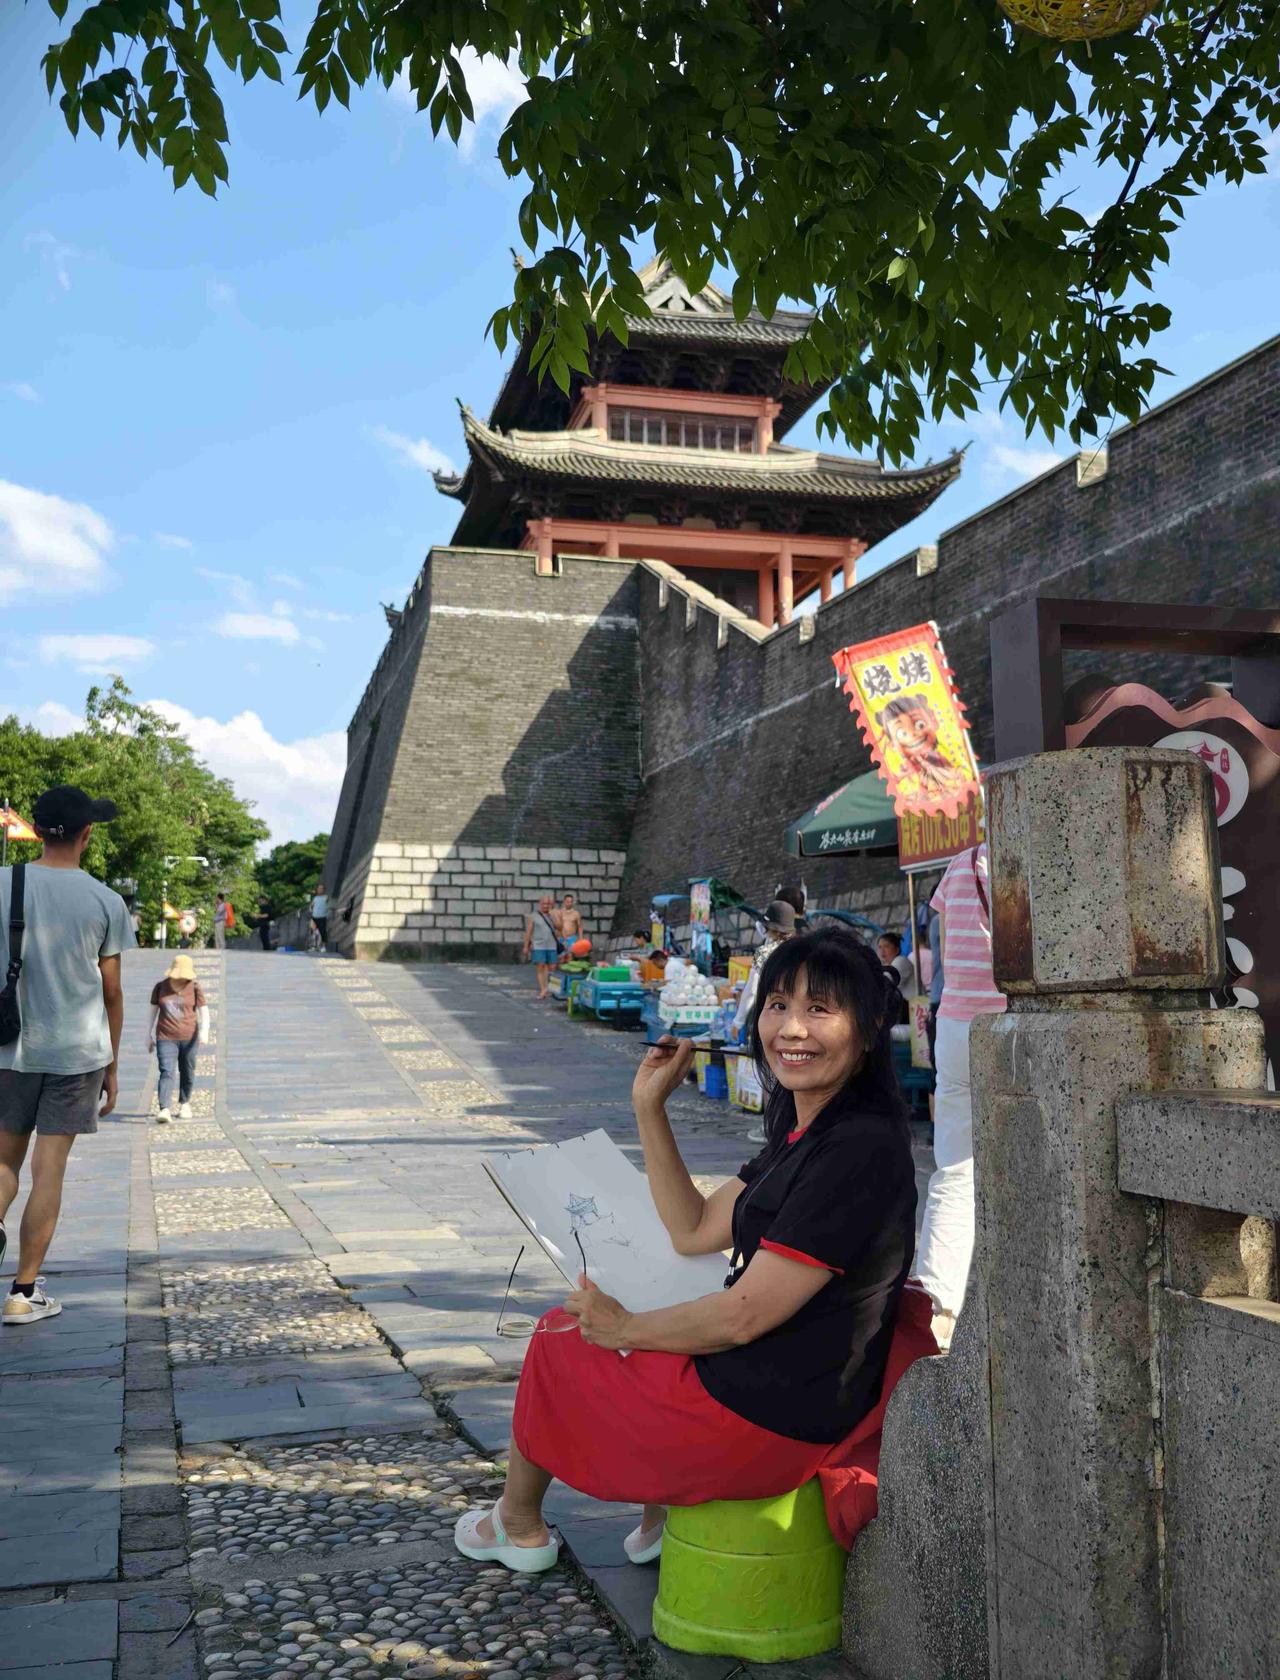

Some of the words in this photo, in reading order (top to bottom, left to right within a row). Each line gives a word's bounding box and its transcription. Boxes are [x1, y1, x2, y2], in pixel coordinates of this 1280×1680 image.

[863, 652, 931, 699] 烧烤
[818, 828, 876, 850] 农夫山泉有点甜
